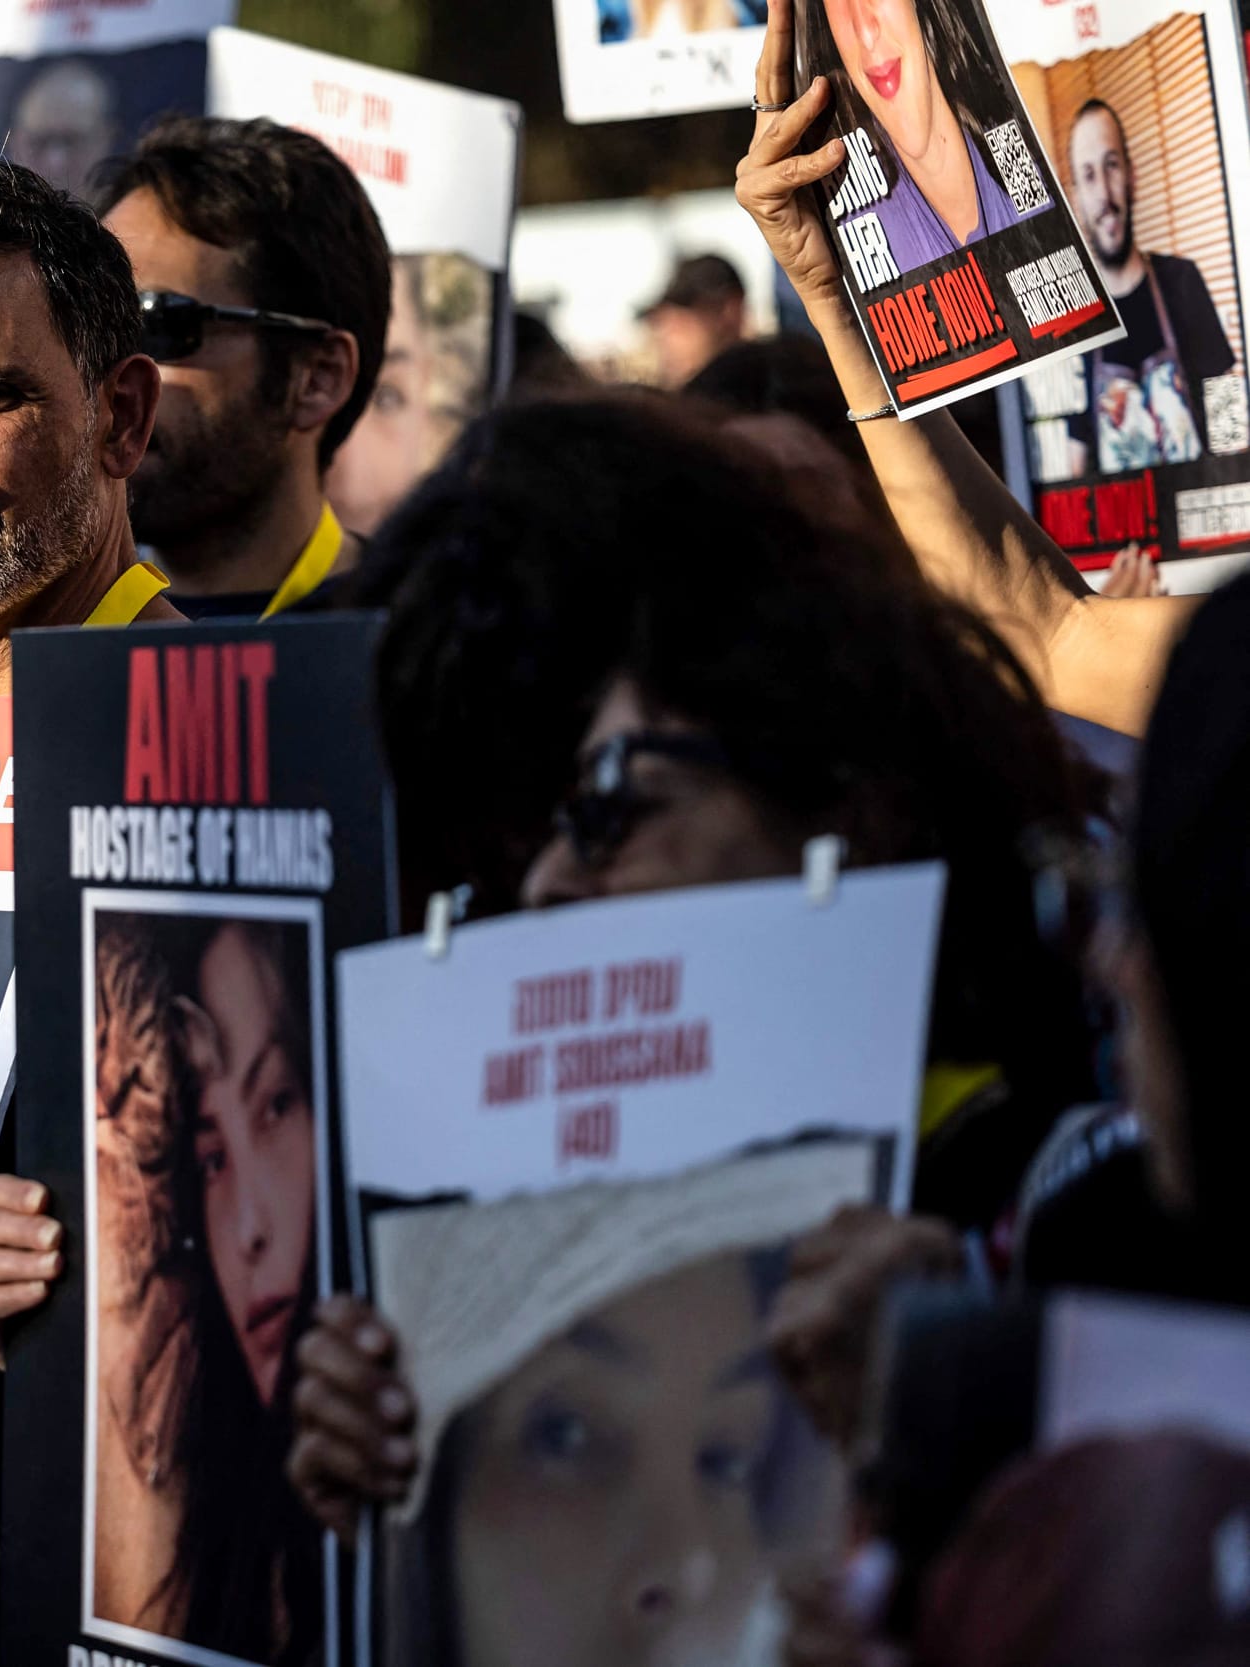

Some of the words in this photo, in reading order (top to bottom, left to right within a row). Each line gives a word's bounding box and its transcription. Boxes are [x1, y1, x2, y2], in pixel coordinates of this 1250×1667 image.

[837, 211, 901, 294] HER
[867, 284, 948, 374] HOME
[930, 250, 1004, 349] NOW!
[1017, 282, 1067, 329] FAMILIES
[1056, 269, 1099, 313] FORUM
[124, 642, 276, 805] AMIT
[69, 805, 194, 882] HOSTAGE
[196, 806, 232, 884] OF
[235, 807, 334, 892] HAMAS
